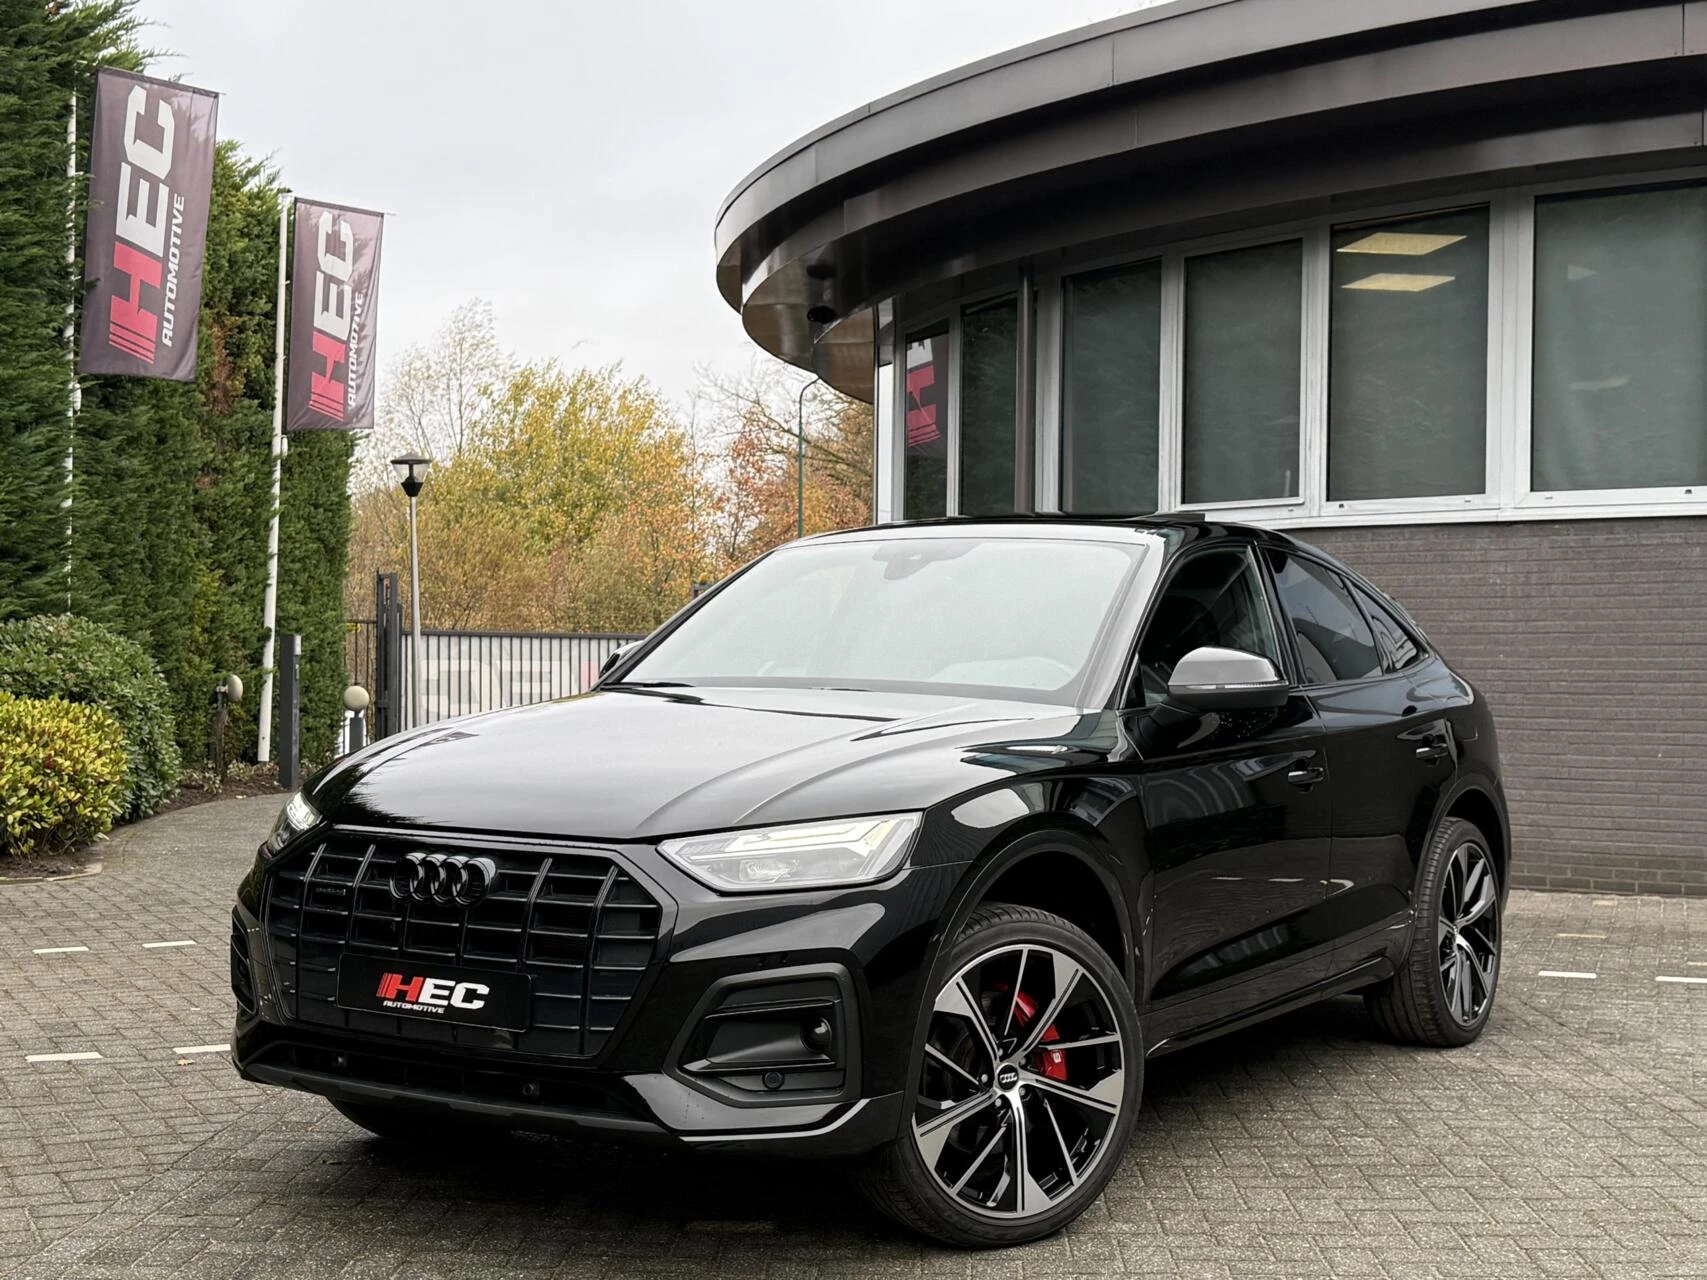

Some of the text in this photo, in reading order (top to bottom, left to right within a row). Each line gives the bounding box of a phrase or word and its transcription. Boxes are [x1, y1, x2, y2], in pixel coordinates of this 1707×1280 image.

[108, 85, 175, 364] HEC
[161, 193, 185, 347] AUTOMOTIVE
[309, 210, 354, 421] HEC
[347, 291, 365, 408] AUTOMOTIVE
[376, 972, 490, 1010] HEC
[383, 1000, 446, 1014] AUTOMOTIVE
